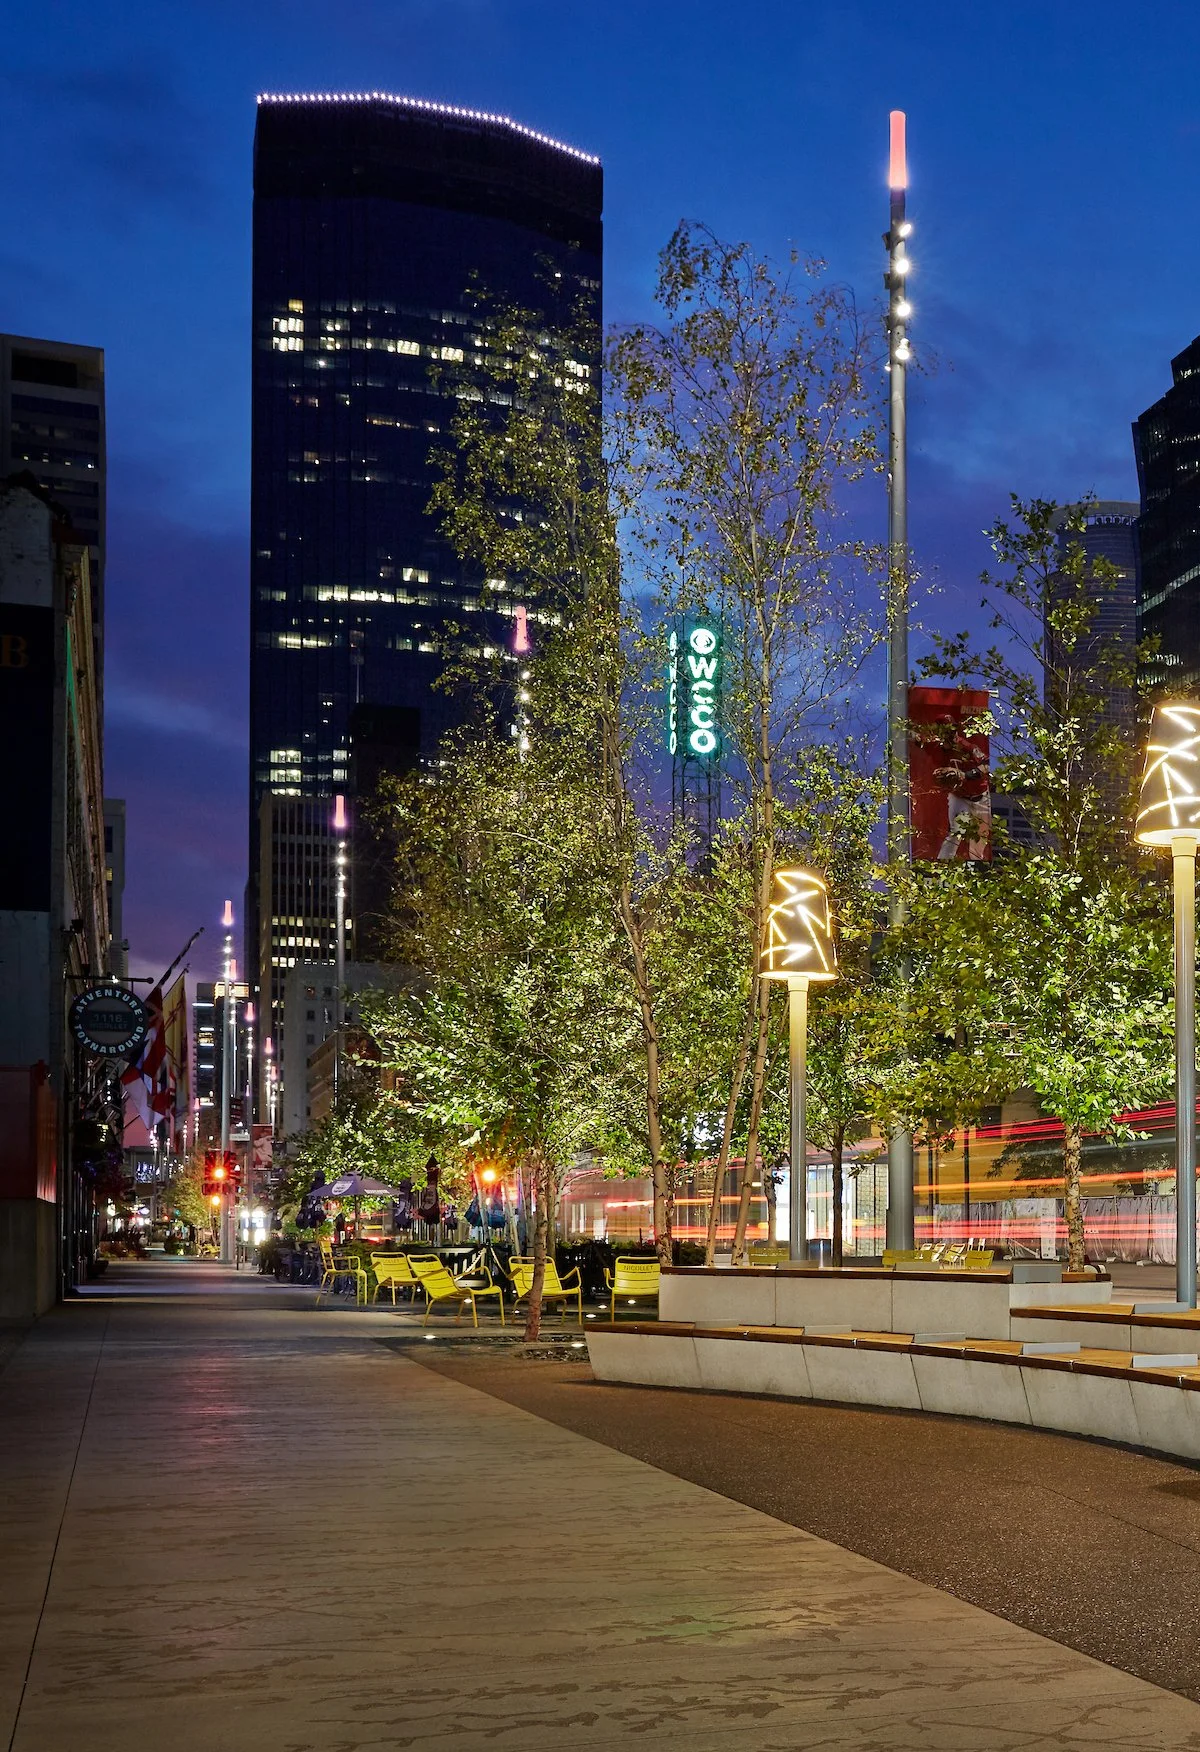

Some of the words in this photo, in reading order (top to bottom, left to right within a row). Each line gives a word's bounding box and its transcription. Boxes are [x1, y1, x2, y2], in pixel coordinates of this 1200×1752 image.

[687, 655, 718, 753] WCCO
[76, 989, 143, 1016] ATVENTURE
[74, 1023, 145, 1054] TOYNAROUND
